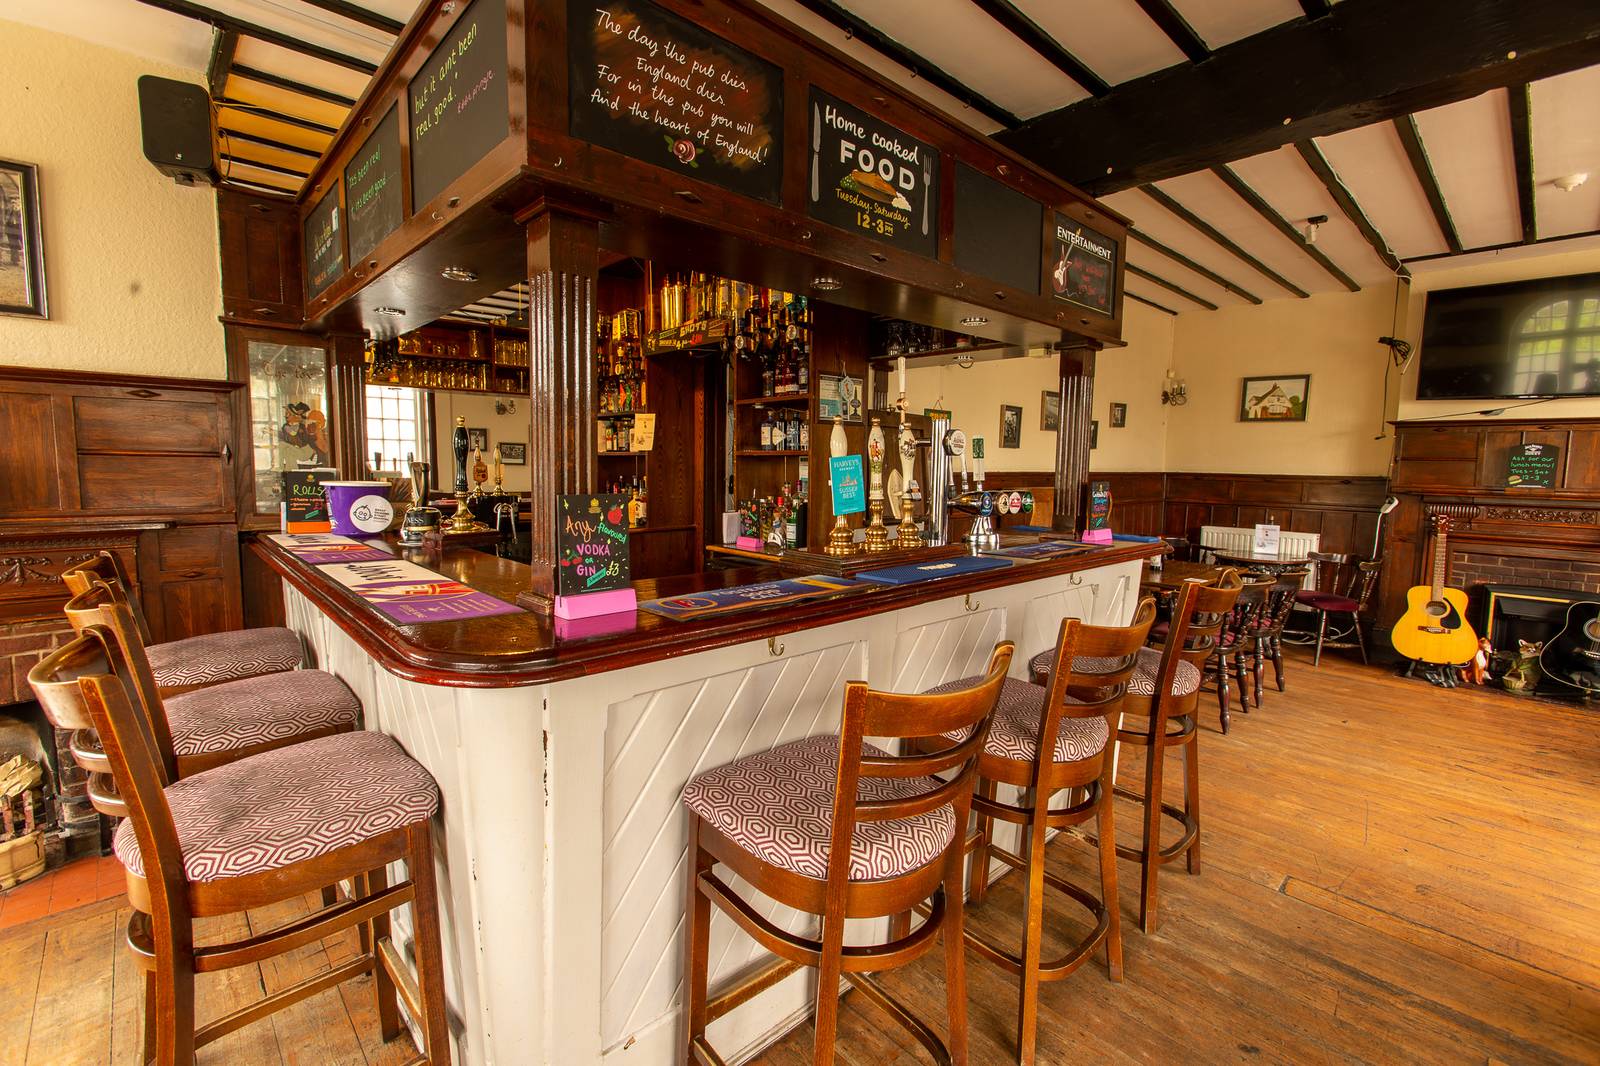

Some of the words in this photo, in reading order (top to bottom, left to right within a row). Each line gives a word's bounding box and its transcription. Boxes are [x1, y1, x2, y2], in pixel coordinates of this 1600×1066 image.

[415, 86, 428, 114] but
[430, 75, 436, 93] it
[458, 23, 477, 56] been
[596, 8, 623, 35] The
[628, 25, 659, 57] day
[664, 41, 686, 65] the
[691, 60, 715, 78] pub
[721, 70, 749, 93] dies.
[597, 64, 621, 84] For
[628, 79, 642, 94] in
[652, 85, 674, 106] the
[681, 101, 704, 117] pub
[711, 113, 732, 129] you
[736, 122, 753, 136] will
[636, 56, 691, 91] England
[696, 82, 726, 106] dies.
[416, 113, 432, 141] real
[590, 88, 620, 111] And
[629, 102, 650, 120] the
[654, 110, 690, 135] heart
[697, 129, 710, 145] of
[715, 134, 768, 165] England!
[825, 104, 866, 139] Home
[872, 132, 920, 165] cooked
[840, 139, 915, 191] FOOD
[1057, 225, 1112, 260] ENTERTAINMENT
[565, 515, 596, 543] Any
[576, 543, 610, 556] VODKA
[576, 564, 596, 577] GIN
[606, 560, 619, 577] £3
